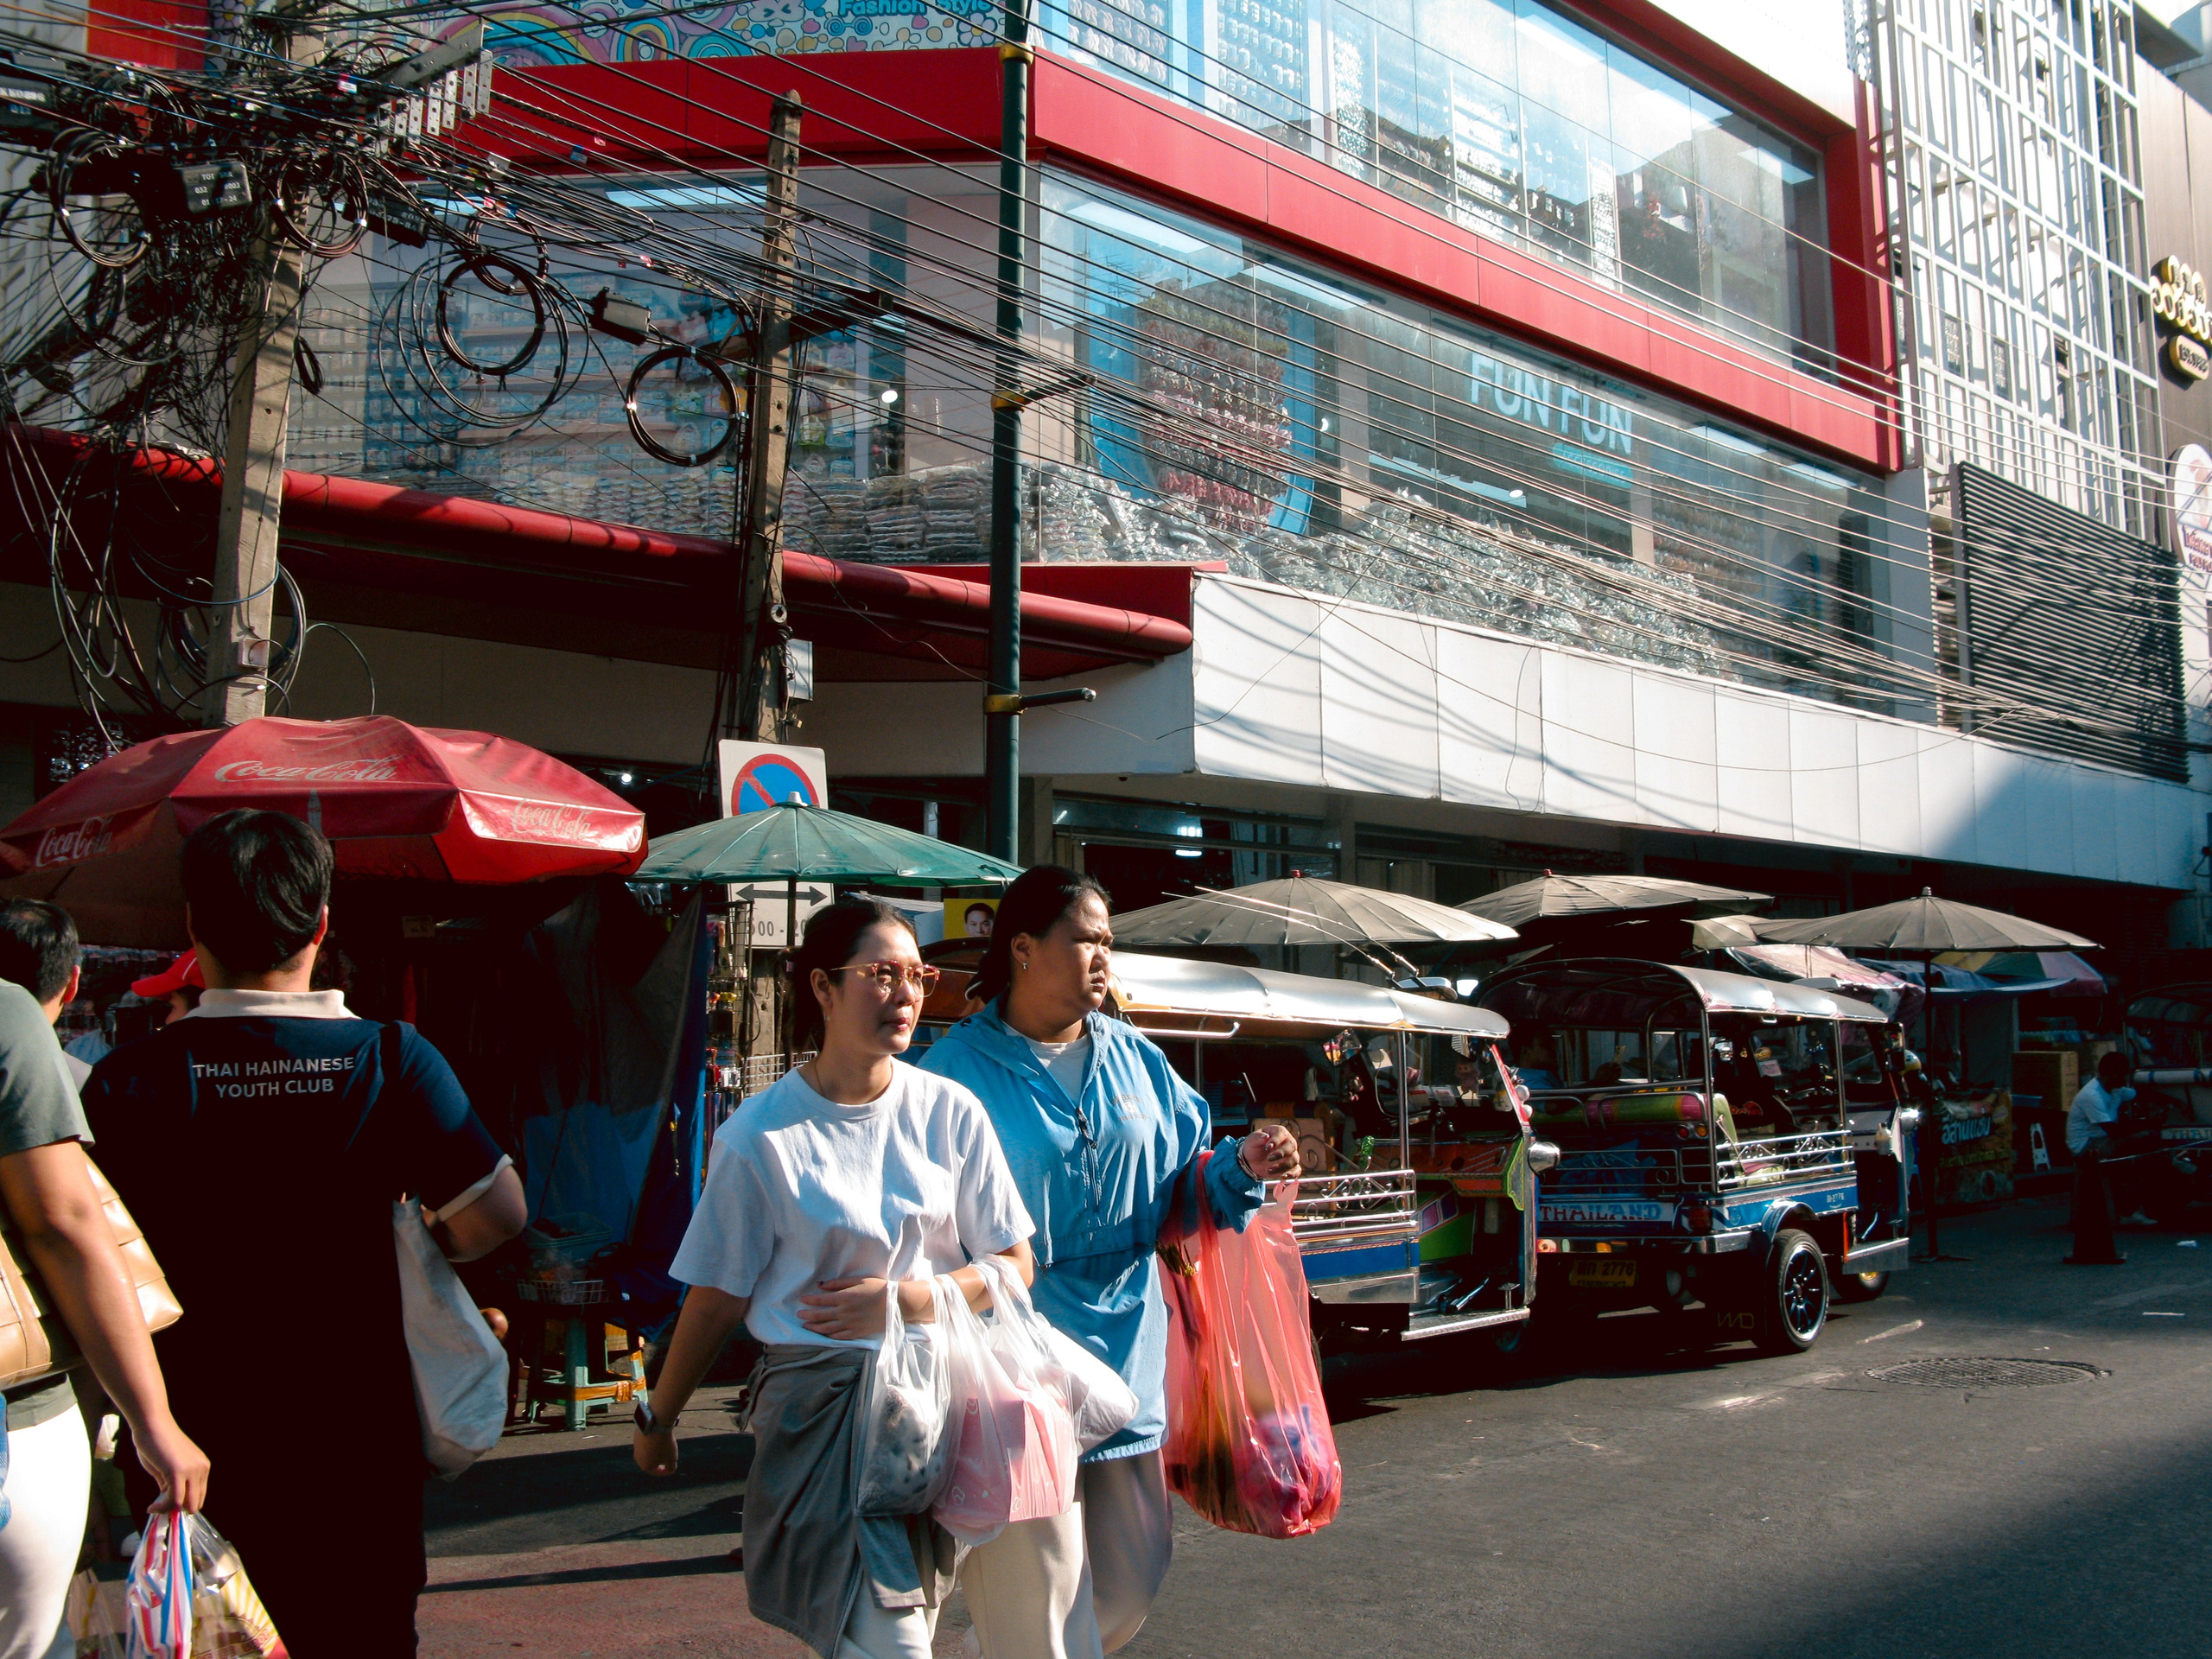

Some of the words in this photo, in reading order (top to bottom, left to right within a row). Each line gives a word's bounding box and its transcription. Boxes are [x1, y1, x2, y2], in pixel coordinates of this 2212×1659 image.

[838, 0, 928, 16] Fashion
[936, 0, 995, 16] Style
[1471, 351, 1551, 429] FUN
[1560, 385, 1633, 455] FUN
[214, 753, 406, 783] Coca-Cola
[192, 1062, 239, 1078] THAI
[245, 1057, 355, 1077] HAINANESE
[215, 1081, 280, 1098] YOUTH
[284, 1078, 334, 1094] CLUB
[1539, 1203, 1662, 1221] THAILAND
[1602, 1262, 1635, 1276] 2776
